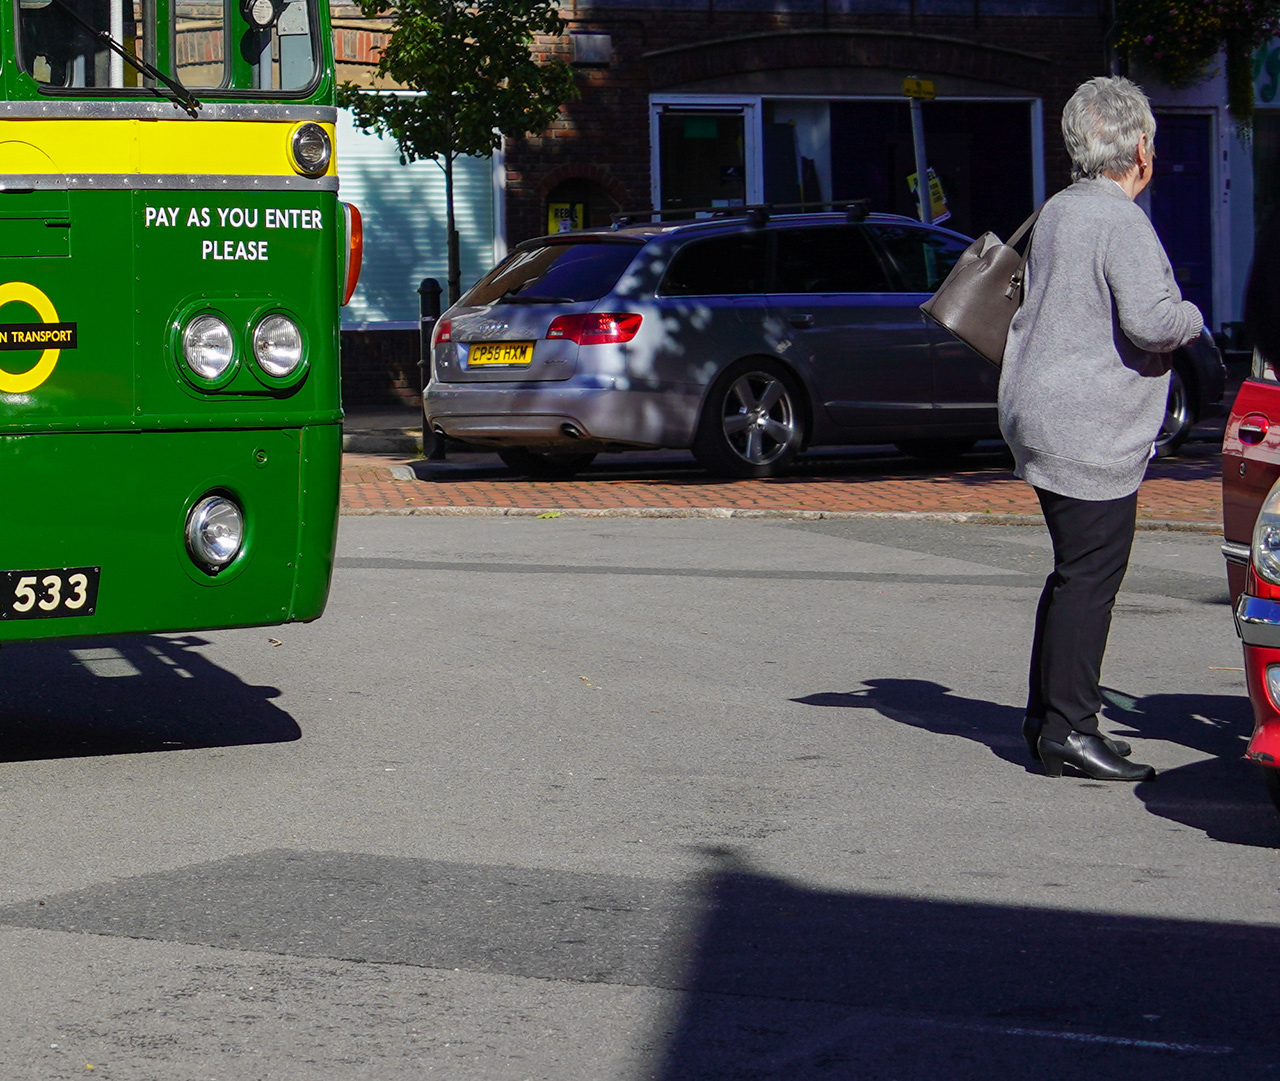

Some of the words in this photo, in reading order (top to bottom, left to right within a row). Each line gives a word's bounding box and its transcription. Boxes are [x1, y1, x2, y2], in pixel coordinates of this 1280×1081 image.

[144, 206, 180, 228] PAY
[187, 207, 211, 228] AS
[217, 207, 258, 229] YOU
[260, 208, 323, 230] ENTER
[202, 240, 269, 261] PLEASE
[11, 329, 73, 344] TRANSPORT
[12, 573, 89, 613] 533
